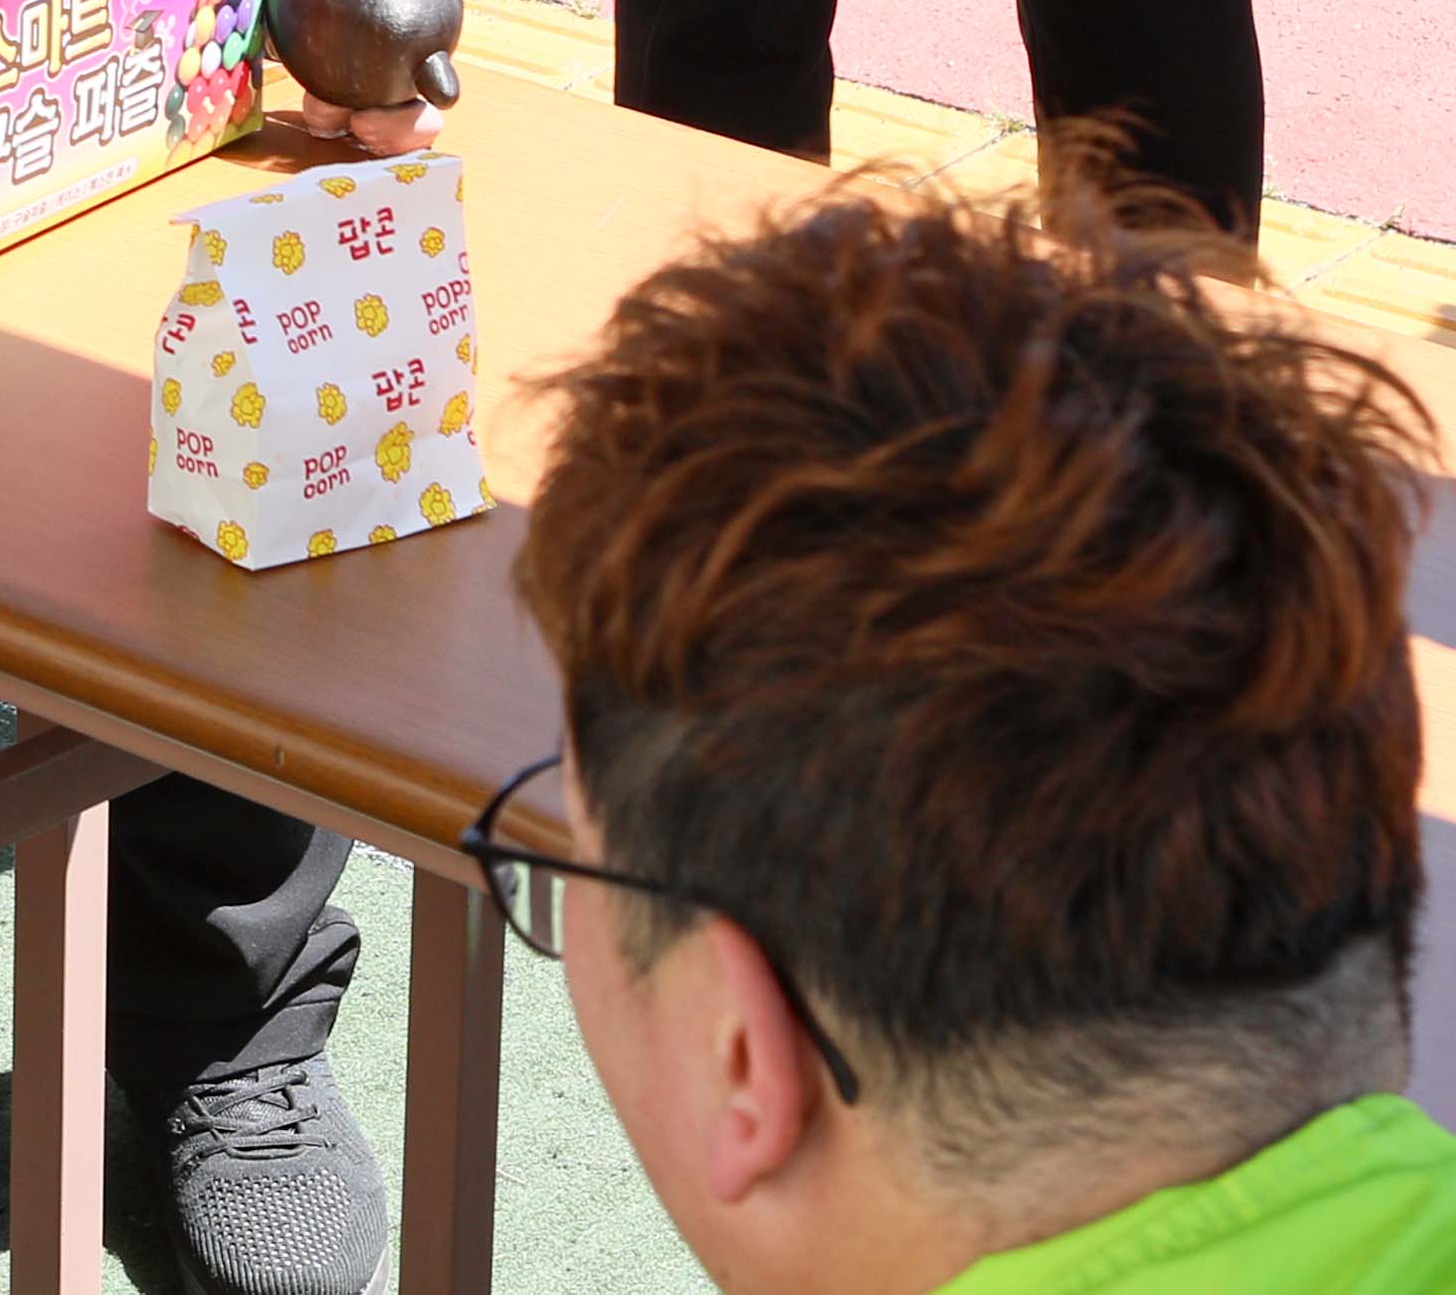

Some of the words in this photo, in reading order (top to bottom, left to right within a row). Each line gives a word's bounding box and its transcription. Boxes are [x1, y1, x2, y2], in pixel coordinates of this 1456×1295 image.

[69, 42, 165, 146] 퍼즐
[337, 206, 396, 261] 팝콘
[287, 322, 333, 355] corn
[372, 358, 426, 413] 팝콘
[176, 453, 219, 479] corn
[303, 467, 351, 500] corn
